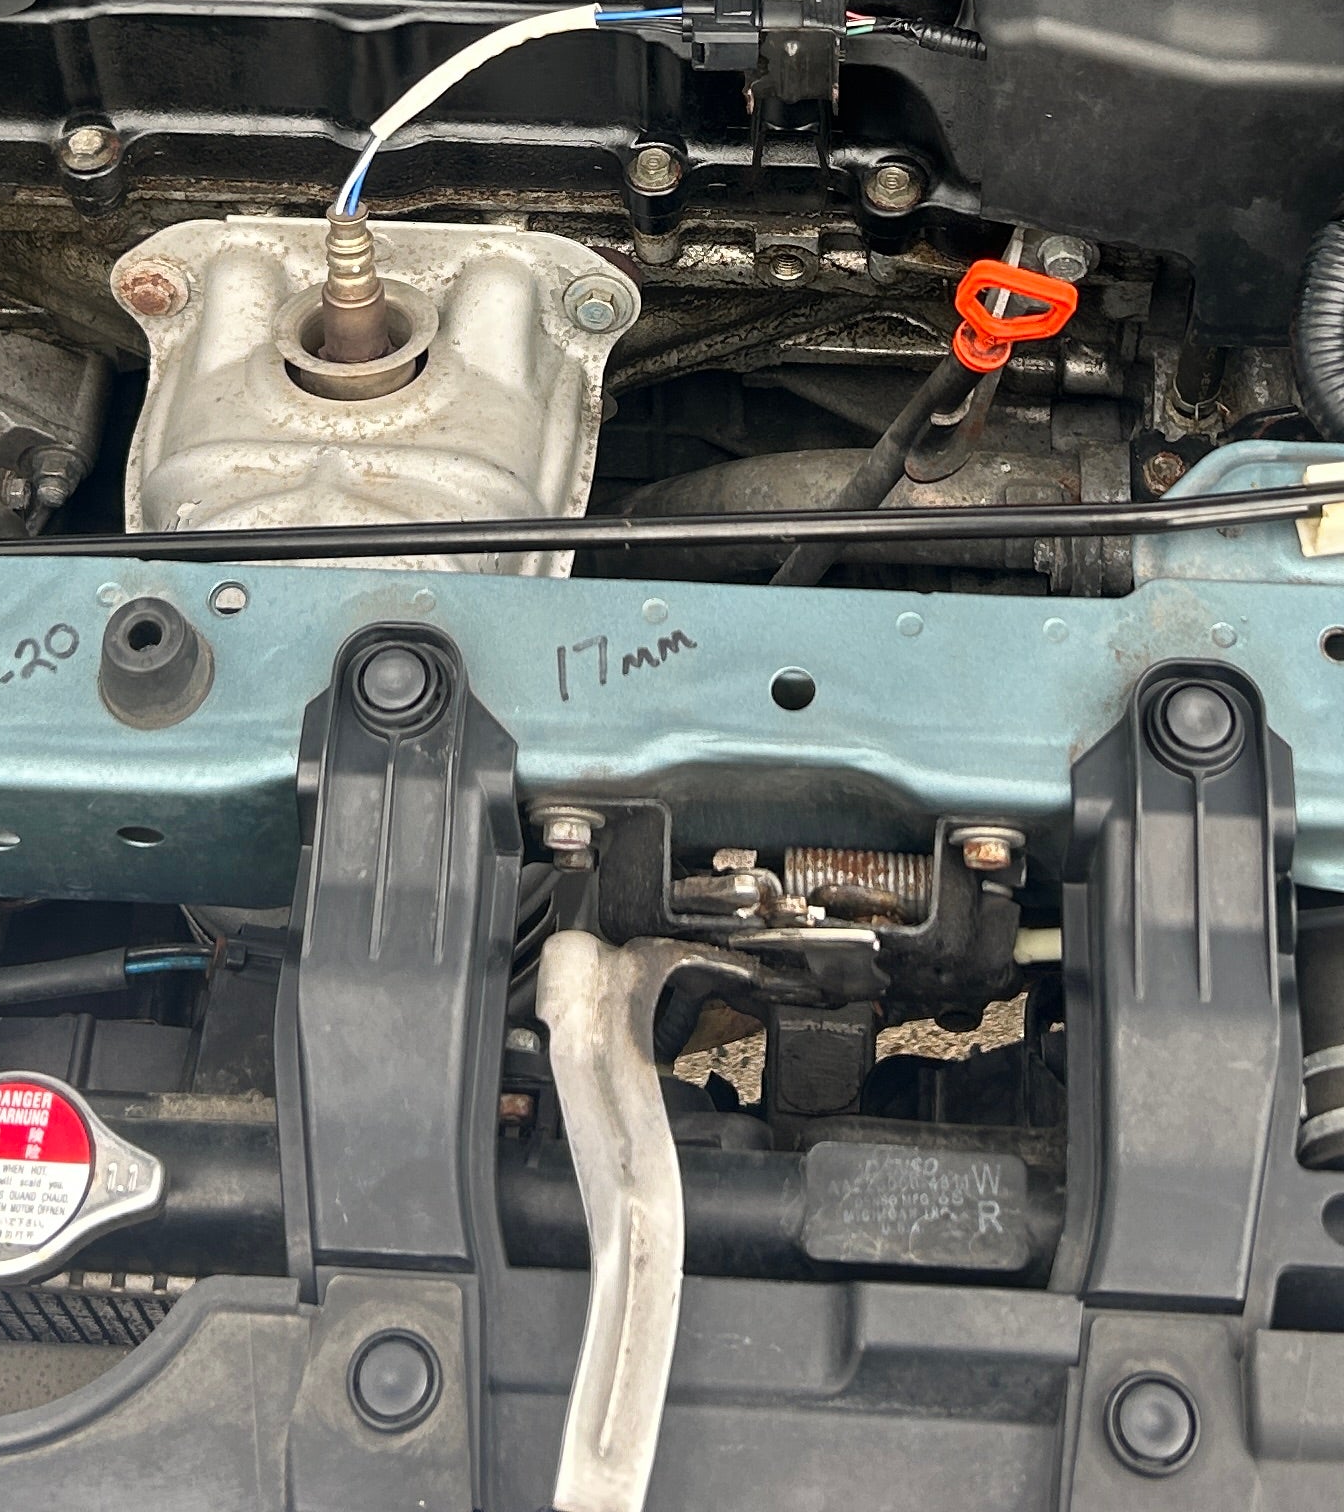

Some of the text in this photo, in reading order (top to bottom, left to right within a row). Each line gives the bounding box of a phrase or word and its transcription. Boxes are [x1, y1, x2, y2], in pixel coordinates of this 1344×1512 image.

[2, 1163, 24, 1174] WHEN
[107, 1161, 140, 1193] 1.1
[968, 1161, 1000, 1196] W
[9, 1190, 36, 1201] QUAND
[10, 1203, 34, 1214] MOTOR
[976, 1199, 1004, 1234] R
